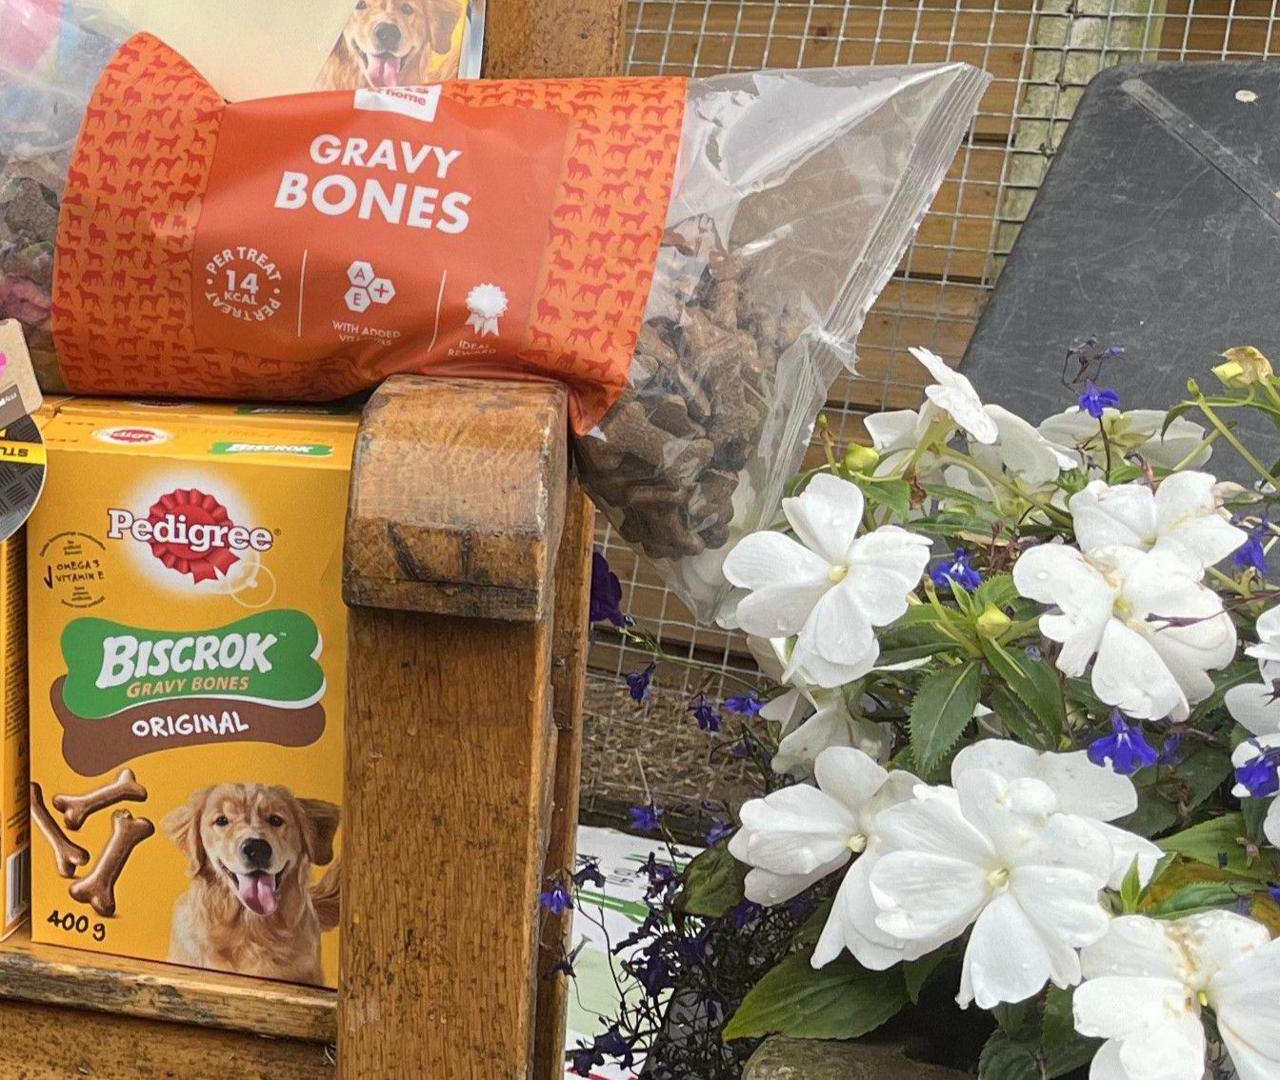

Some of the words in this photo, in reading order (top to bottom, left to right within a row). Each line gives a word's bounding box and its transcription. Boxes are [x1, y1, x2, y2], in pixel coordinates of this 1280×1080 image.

[310, 134, 462, 179] GRAVY
[274, 171, 472, 234] BONES
[205, 248, 234, 274] PER
[237, 246, 282, 282] TREAT
[226, 270, 259, 293] 14
[224, 292, 257, 306] KCAL
[332, 320, 358, 334] WITH
[361, 328, 401, 339] ADDED
[106, 507, 273, 552] Pedigree
[56, 561, 91, 571] OMEGA
[56, 573, 95, 582] VITAMIN
[95, 632, 279, 690] BISCROK
[125, 676, 187, 698] GRAVY
[191, 676, 249, 693] BONES
[131, 711, 249, 739] ORIGINAL
